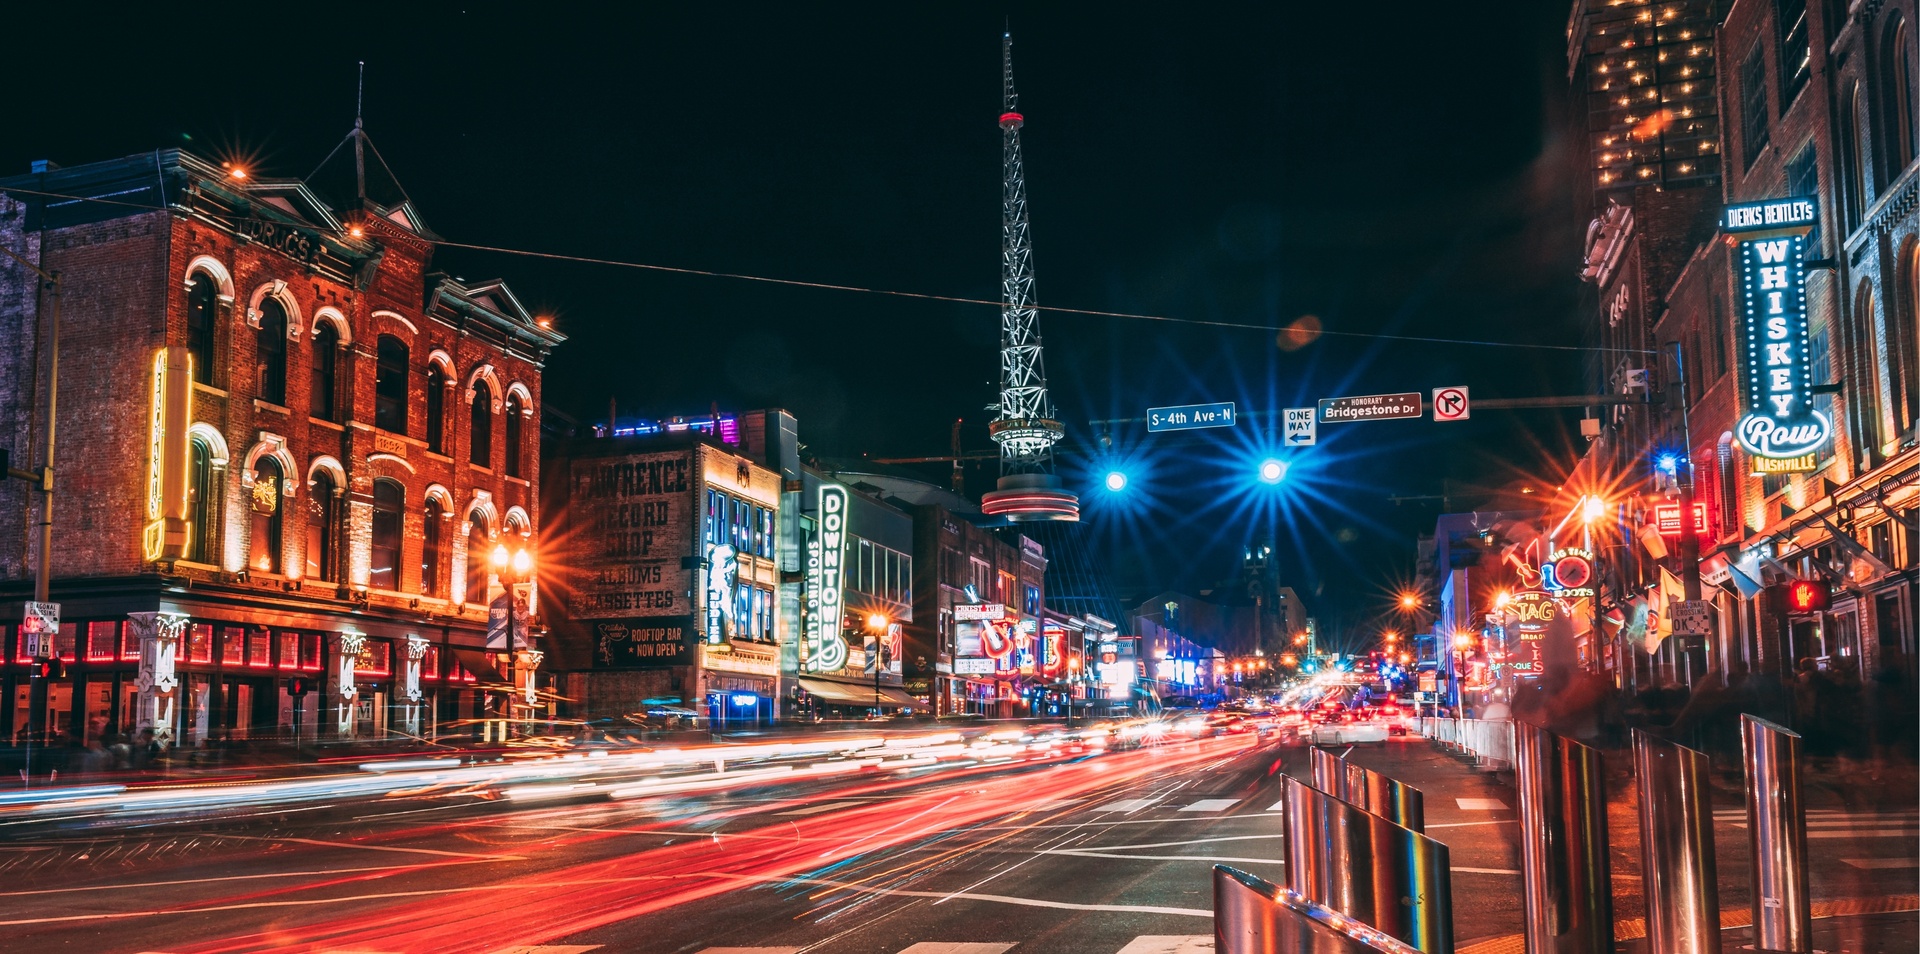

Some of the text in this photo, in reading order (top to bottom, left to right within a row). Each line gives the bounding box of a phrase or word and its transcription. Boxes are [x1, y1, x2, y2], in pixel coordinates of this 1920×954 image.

[1728, 205, 1763, 228] DIERKS
[1754, 240, 1792, 417] WHISKEY
[1325, 403, 1415, 419] Bridgestone Dr
[1351, 397, 1383, 406] HONORARY
[1288, 411, 1311, 421] ONE
[1288, 421, 1312, 431] WAY
[1746, 416, 1822, 450] Row
[1756, 453, 1816, 472] NASHVILLE
[573, 458, 687, 499] LAWRENCE
[595, 501, 668, 530] RECORD
[606, 530, 654, 557] SHOP
[1548, 548, 1593, 562] BIG TIME
[598, 566, 662, 586] ALBUMS
[808, 541, 819, 608] SPORTING
[823, 494, 841, 641] DOWNTOWN
[584, 590, 674, 610] CASSETTES
[1554, 588, 1594, 598] BOOTS
[1675, 601, 1705, 609] DIAGONAL
[1675, 608, 1705, 616] CROSSING
[631, 627, 682, 642] ROOFTOP BAR
[807, 614, 818, 648] CLUB
[1673, 619, 1689, 631] OK
[636, 643, 677, 657] NOW OPEN
